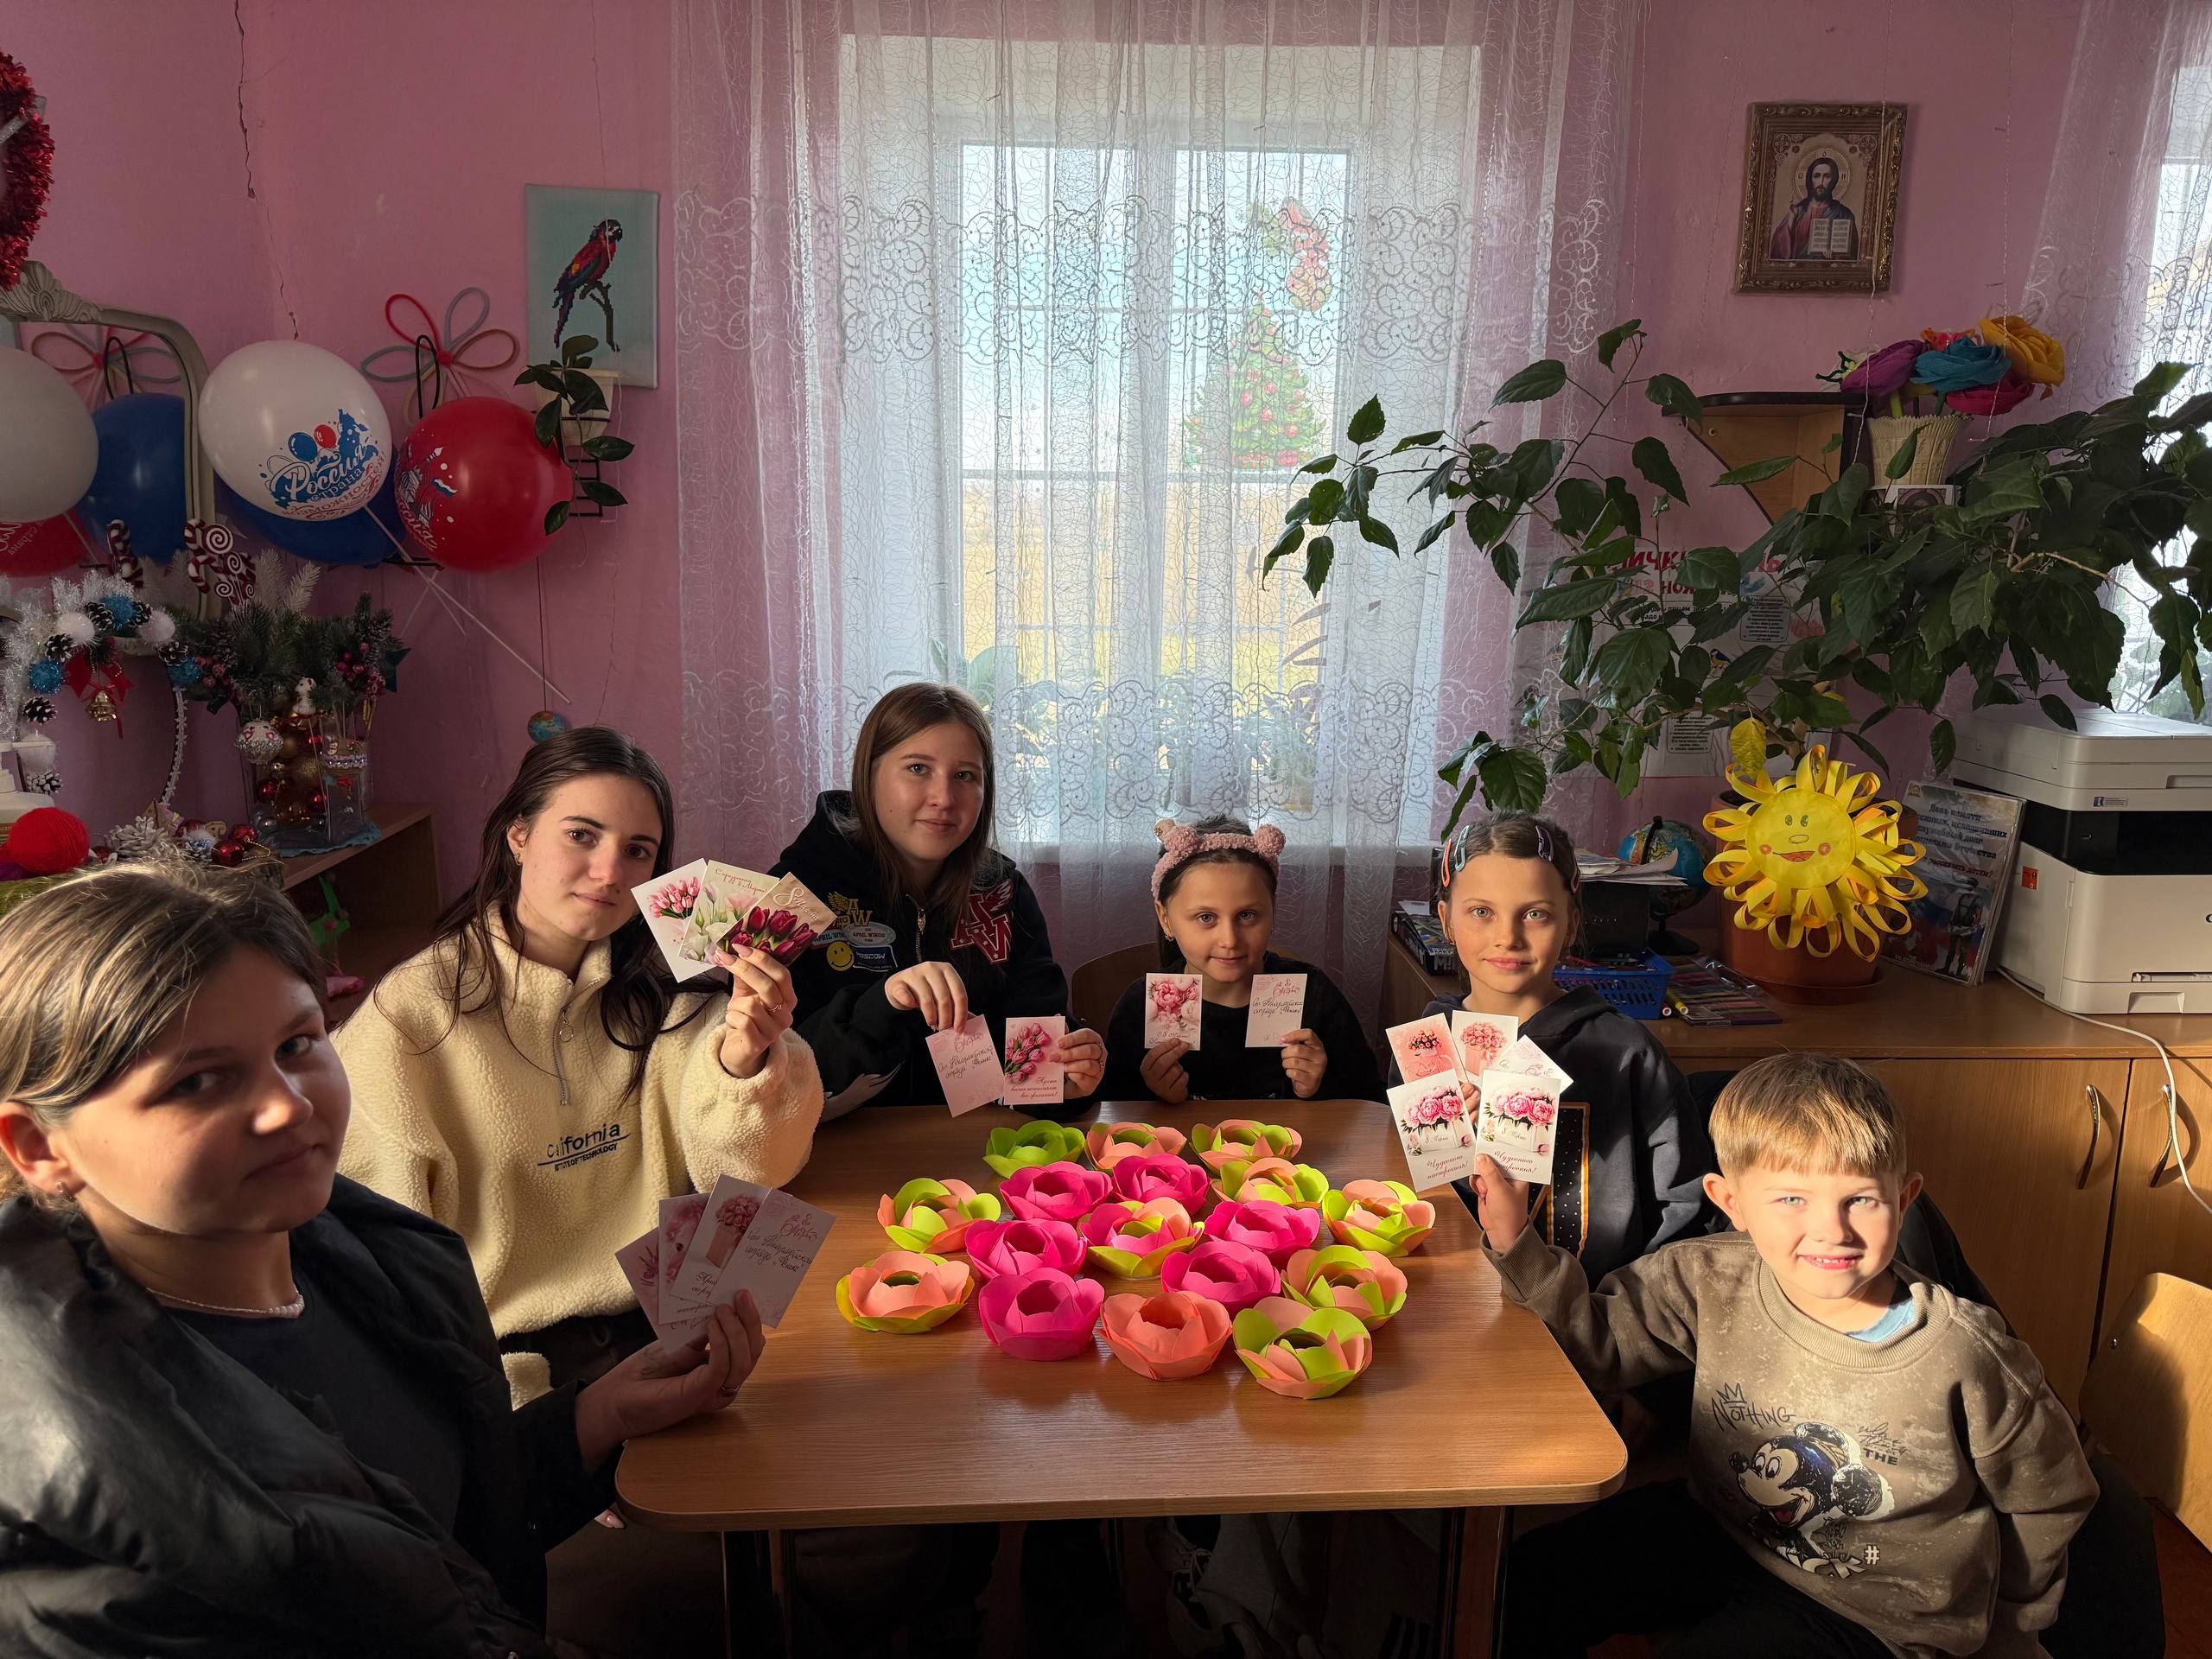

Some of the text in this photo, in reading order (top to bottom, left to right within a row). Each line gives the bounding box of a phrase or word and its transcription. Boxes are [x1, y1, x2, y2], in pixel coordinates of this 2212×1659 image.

[270, 443, 365, 503] Россия
[311, 467, 363, 502] страна
[1427, 1154, 1464, 1170] Чудесного
[1494, 1150, 1534, 1166] Чудесного
[1427, 1160, 1469, 1179] настроения!
[1712, 1396, 1796, 1432] NOTHING
[1863, 1447, 1898, 1466] THE
